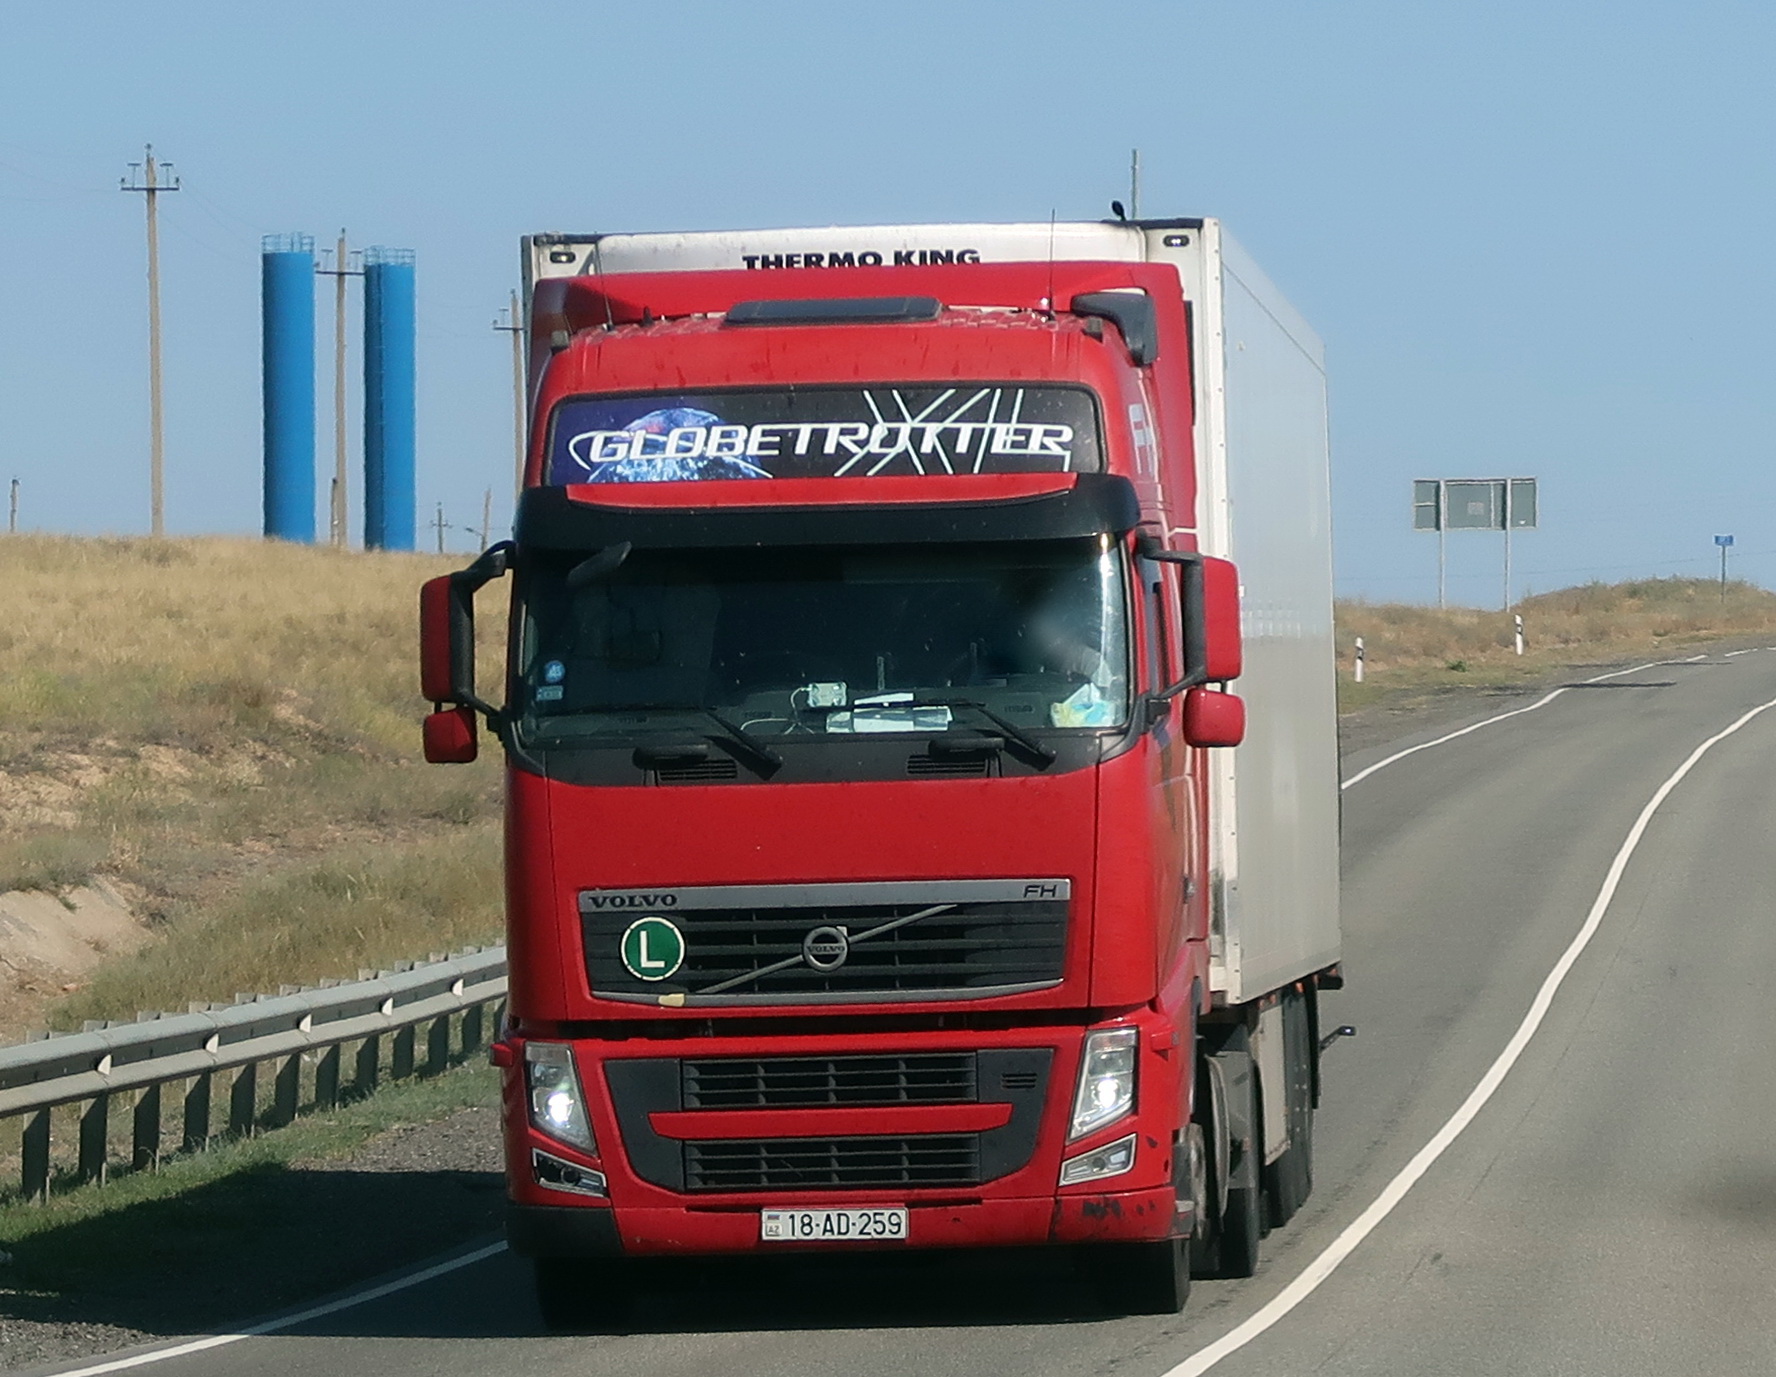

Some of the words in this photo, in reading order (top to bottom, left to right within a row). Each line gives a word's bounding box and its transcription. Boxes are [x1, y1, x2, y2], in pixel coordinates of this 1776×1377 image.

[742, 251, 883, 269] THERMO
[894, 249, 980, 266] KING
[574, 420, 1074, 465] GLOBETROTTER
[588, 893, 678, 909] VOLVO
[1023, 884, 1057, 898] FH
[640, 930, 666, 968] L
[806, 945, 846, 953] VOLVO
[788, 1212, 902, 1237] 18-AD-259
